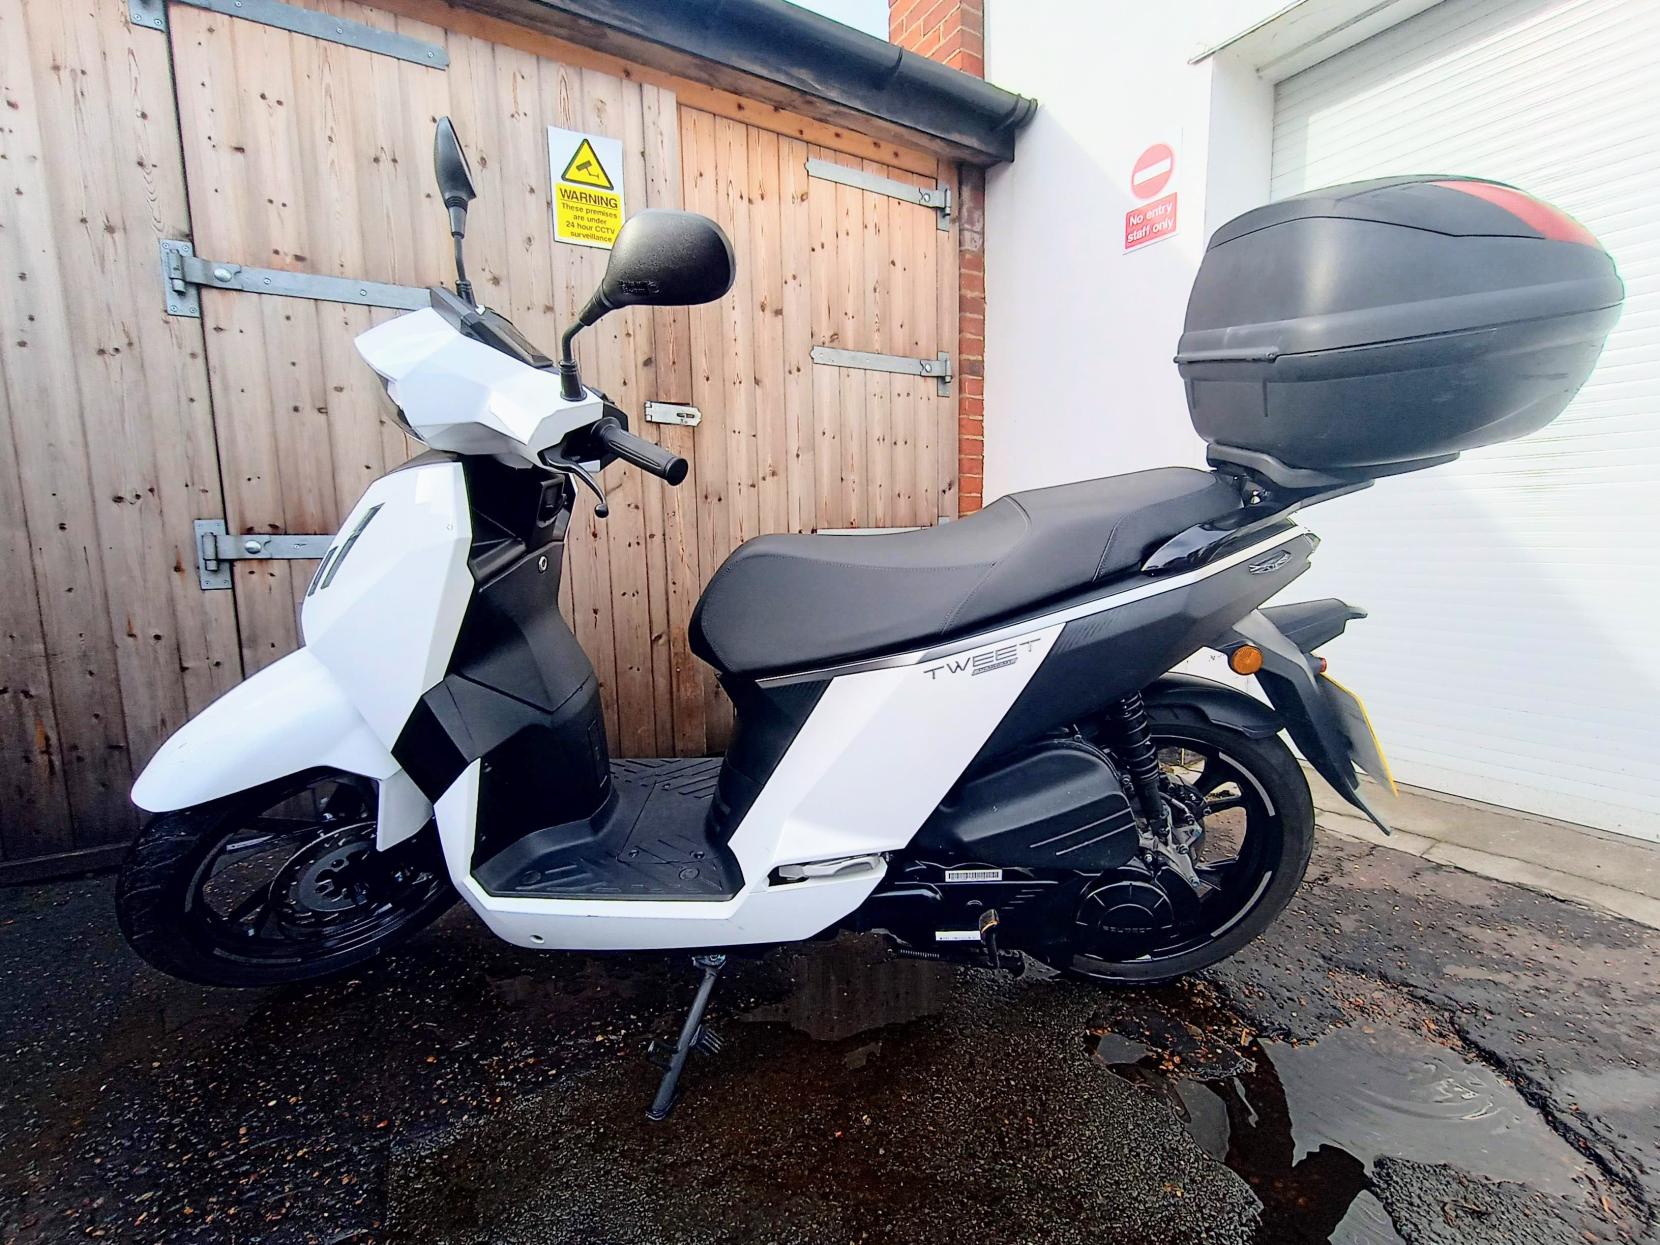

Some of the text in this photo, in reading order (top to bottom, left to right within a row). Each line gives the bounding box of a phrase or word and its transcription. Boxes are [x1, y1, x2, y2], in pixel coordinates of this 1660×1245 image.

[560, 188, 618, 208] WARNING
[562, 202, 618, 219] These premises
[573, 213, 607, 225] are under
[1129, 202, 1172, 227] No entry
[566, 220, 616, 235] 24 hour CCTV
[570, 231, 613, 242] surveillance
[1127, 217, 1174, 242] staff only
[923, 638, 1041, 680] TWEET
